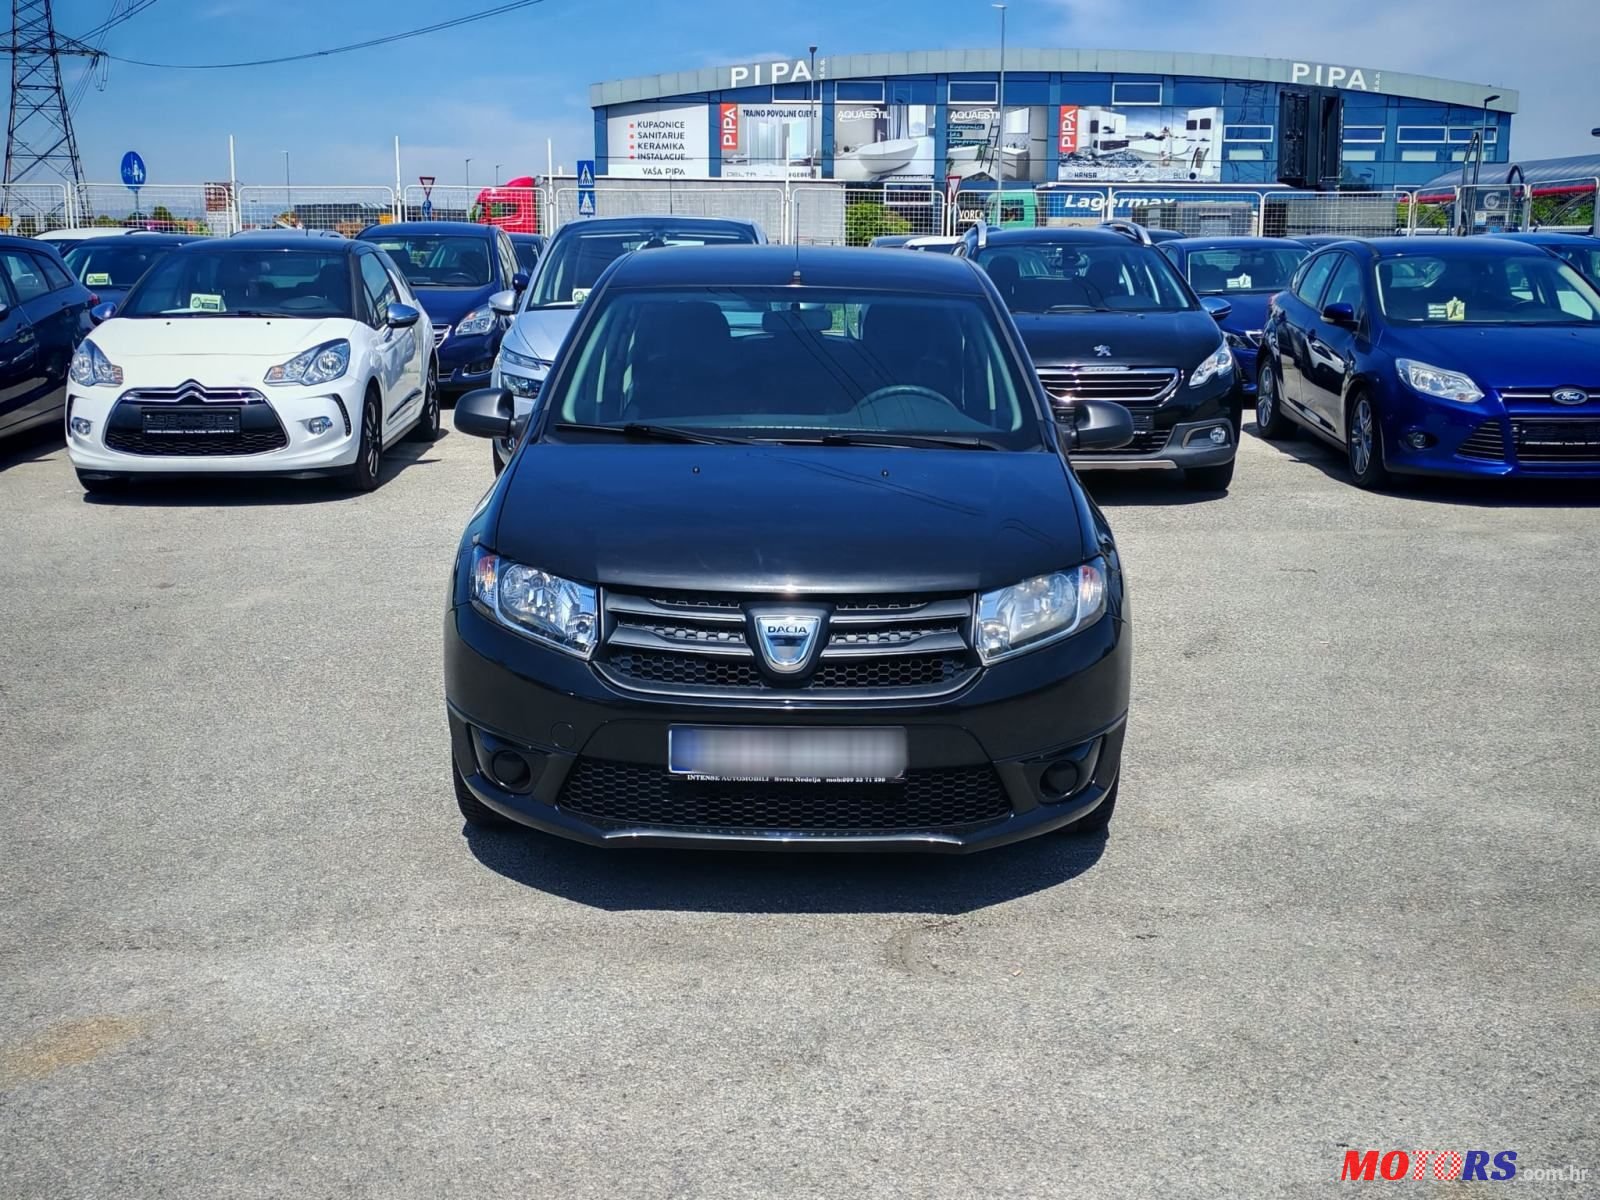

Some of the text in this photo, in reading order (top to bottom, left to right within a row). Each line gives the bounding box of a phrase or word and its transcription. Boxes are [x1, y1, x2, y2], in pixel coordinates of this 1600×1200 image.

[731, 60, 812, 88] PIPA
[1291, 62, 1367, 91] PIPA
[743, 109, 766, 118] TRAJNO
[767, 109, 797, 118] POVOLJNE
[837, 108, 891, 121] AQUAESTIL
[951, 108, 1001, 121] AQUAESTI
[637, 120, 685, 129] KUPAONICE
[722, 107, 737, 146] PIPA
[1062, 109, 1076, 148] PIPA
[637, 131, 685, 140] SANITARIJE
[637, 142, 685, 150] KERAMIKA
[637, 153, 686, 161] INSTALACIJE
[642, 166, 686, 176] VAŠA PIPA
[767, 626, 808, 634] DACIA
[687, 774, 720, 782] INTENSE
